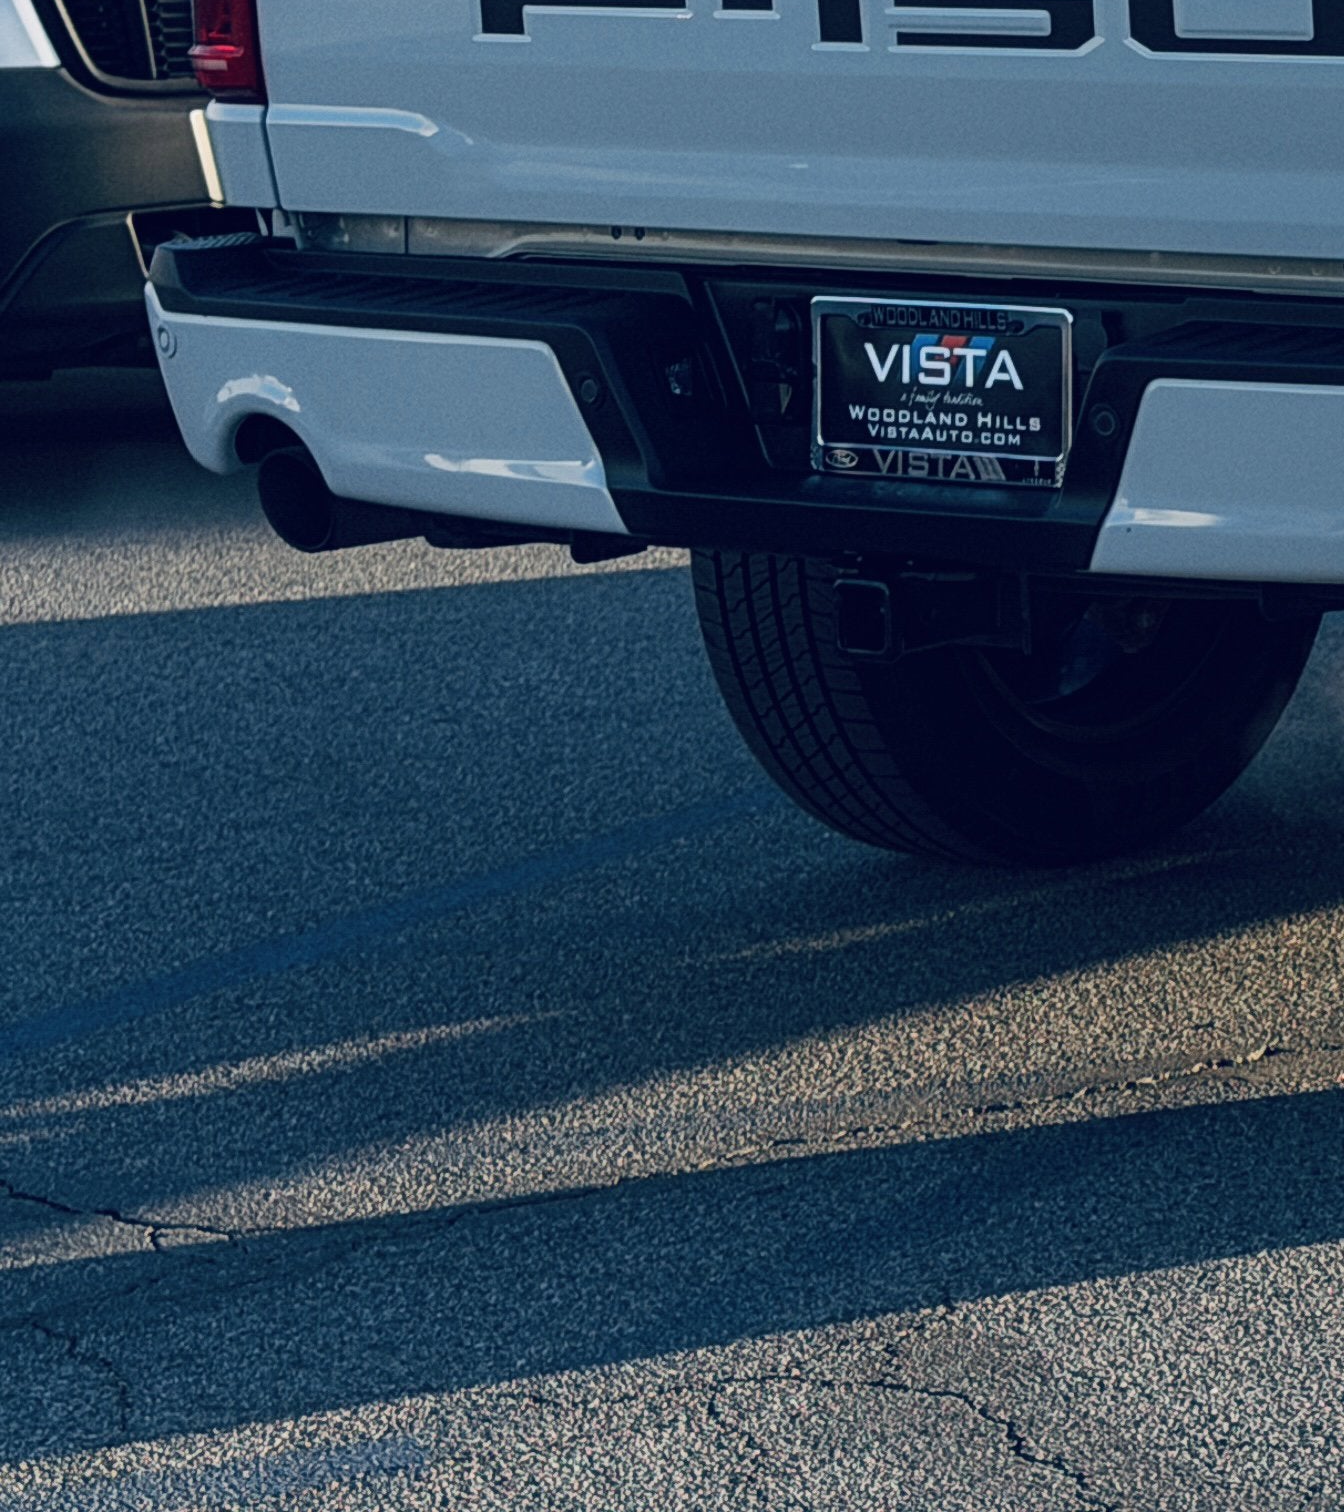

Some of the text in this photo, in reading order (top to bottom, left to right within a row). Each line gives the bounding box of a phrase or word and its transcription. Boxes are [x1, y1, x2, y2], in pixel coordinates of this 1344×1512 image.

[872, 306, 1007, 331] WOODLAND HILLS
[863, 342, 1024, 391] VISTA
[849, 404, 1041, 432] WOODLAND HILLS
[872, 449, 976, 481] VISTA
